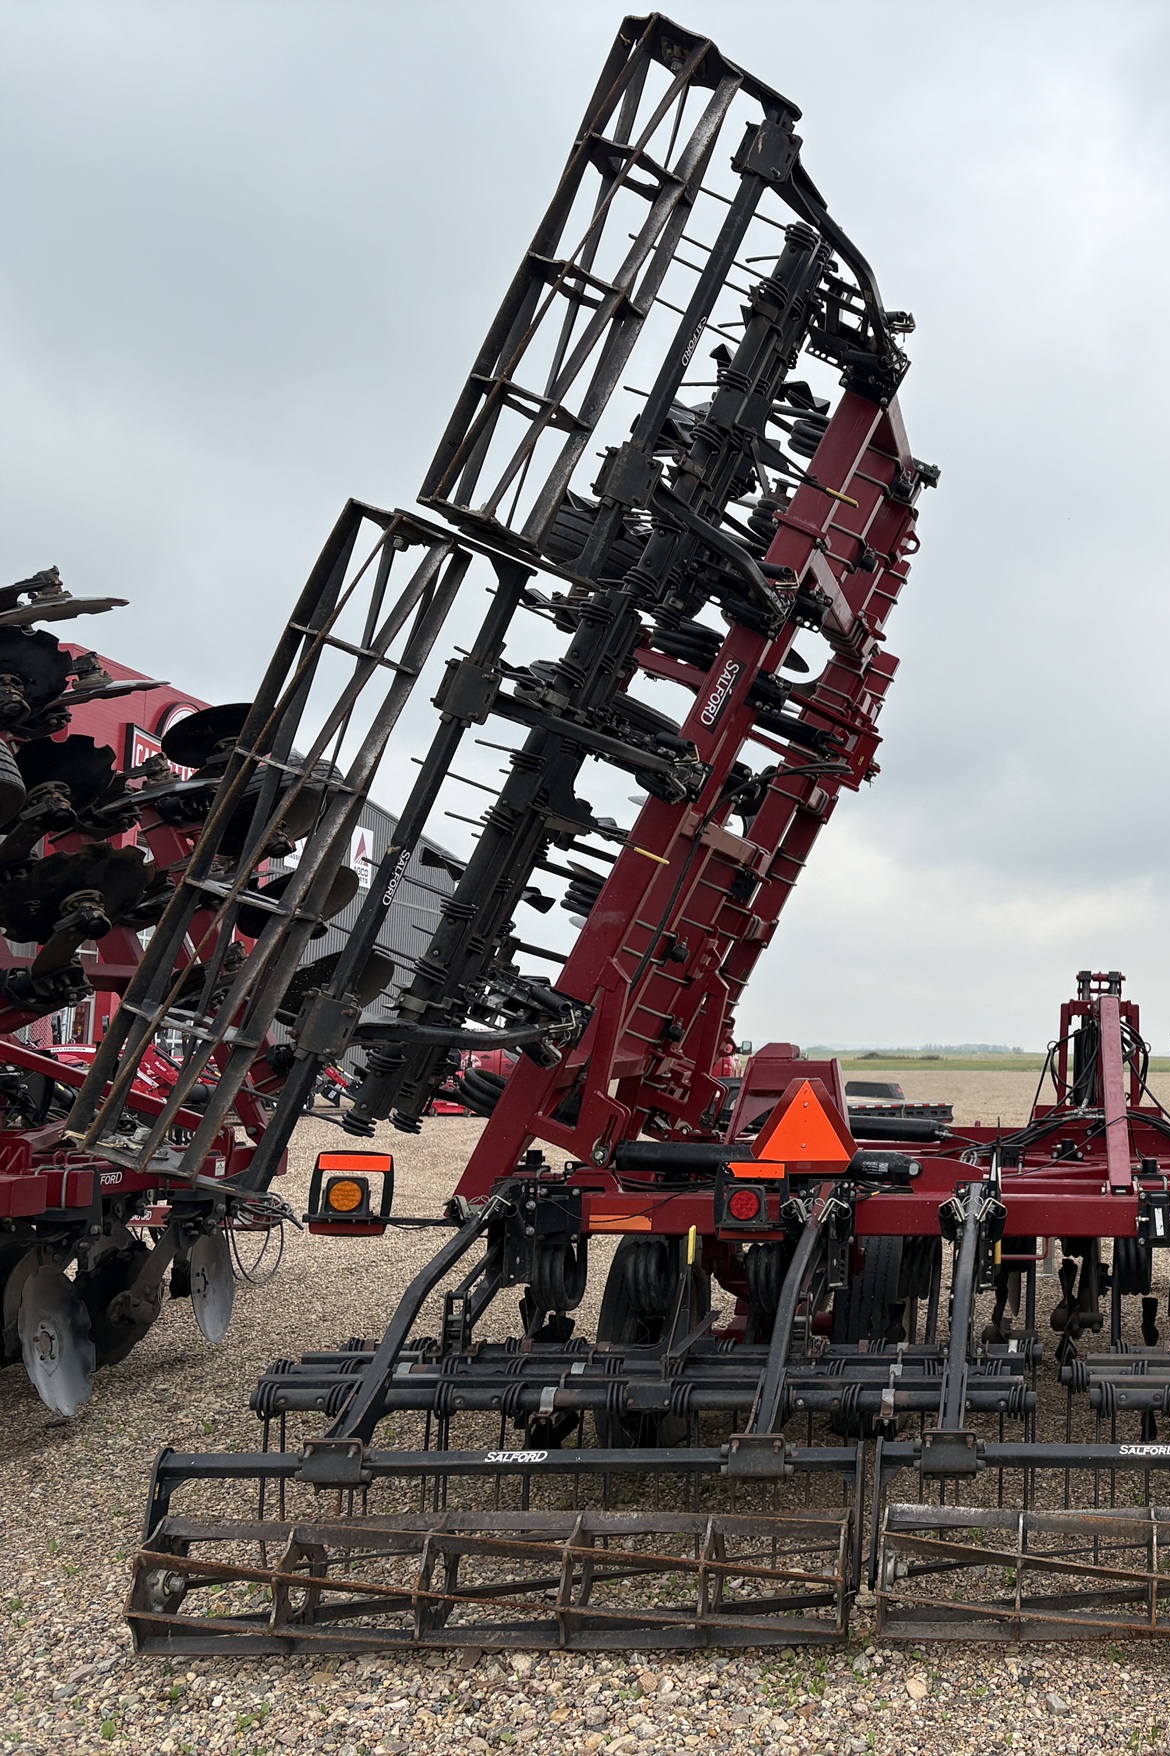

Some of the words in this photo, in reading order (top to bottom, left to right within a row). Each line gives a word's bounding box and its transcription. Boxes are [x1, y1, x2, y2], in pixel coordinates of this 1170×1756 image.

[700, 659, 740, 726] SALFORD
[382, 848, 411, 906] SALFORD
[100, 1171, 123, 1186] FORD
[484, 1450, 549, 1463] SALFORD
